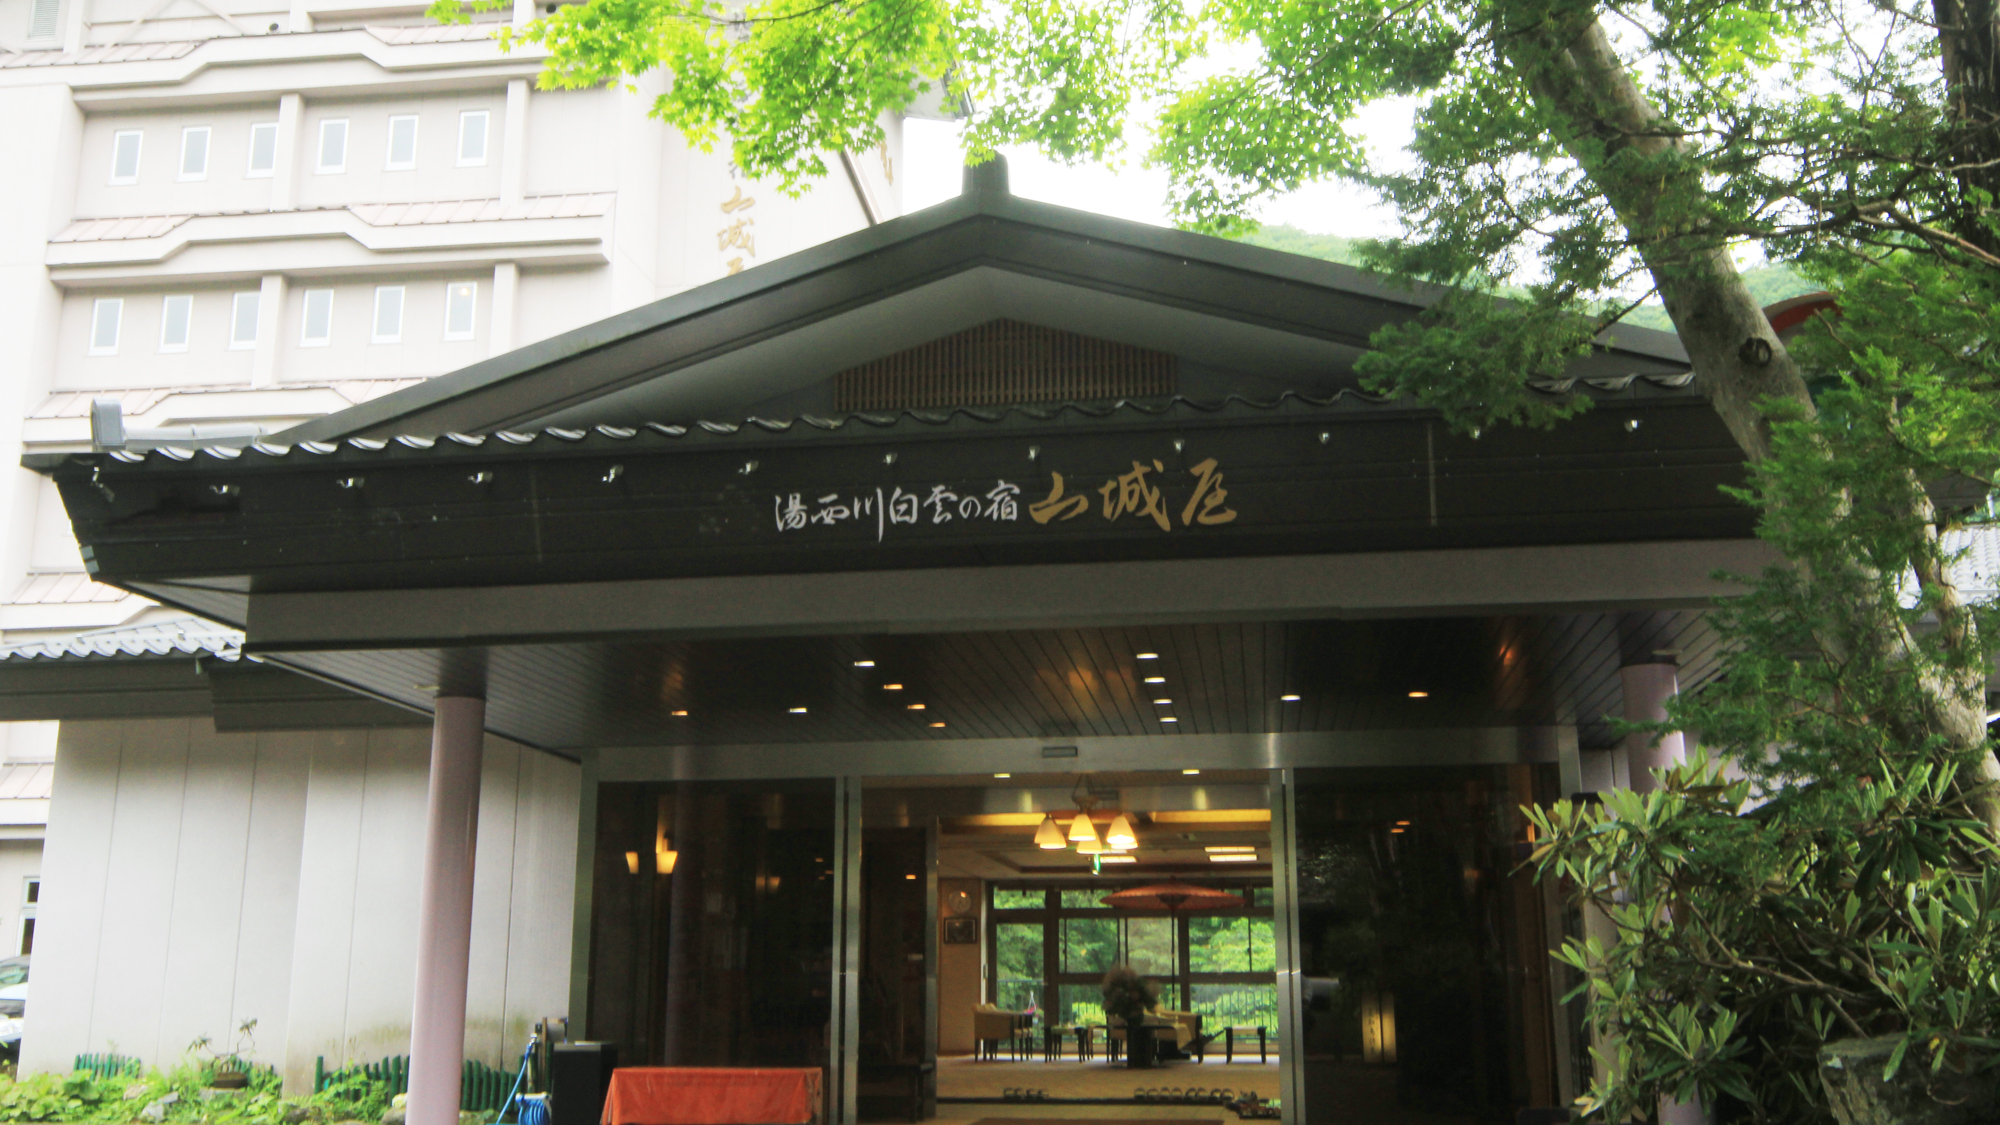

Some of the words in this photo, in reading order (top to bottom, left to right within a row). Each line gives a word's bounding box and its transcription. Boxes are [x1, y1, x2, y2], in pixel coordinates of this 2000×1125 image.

[775, 480, 1021, 543] 湯西川白雲の宿
[1028, 458, 1238, 532] 山城屋
